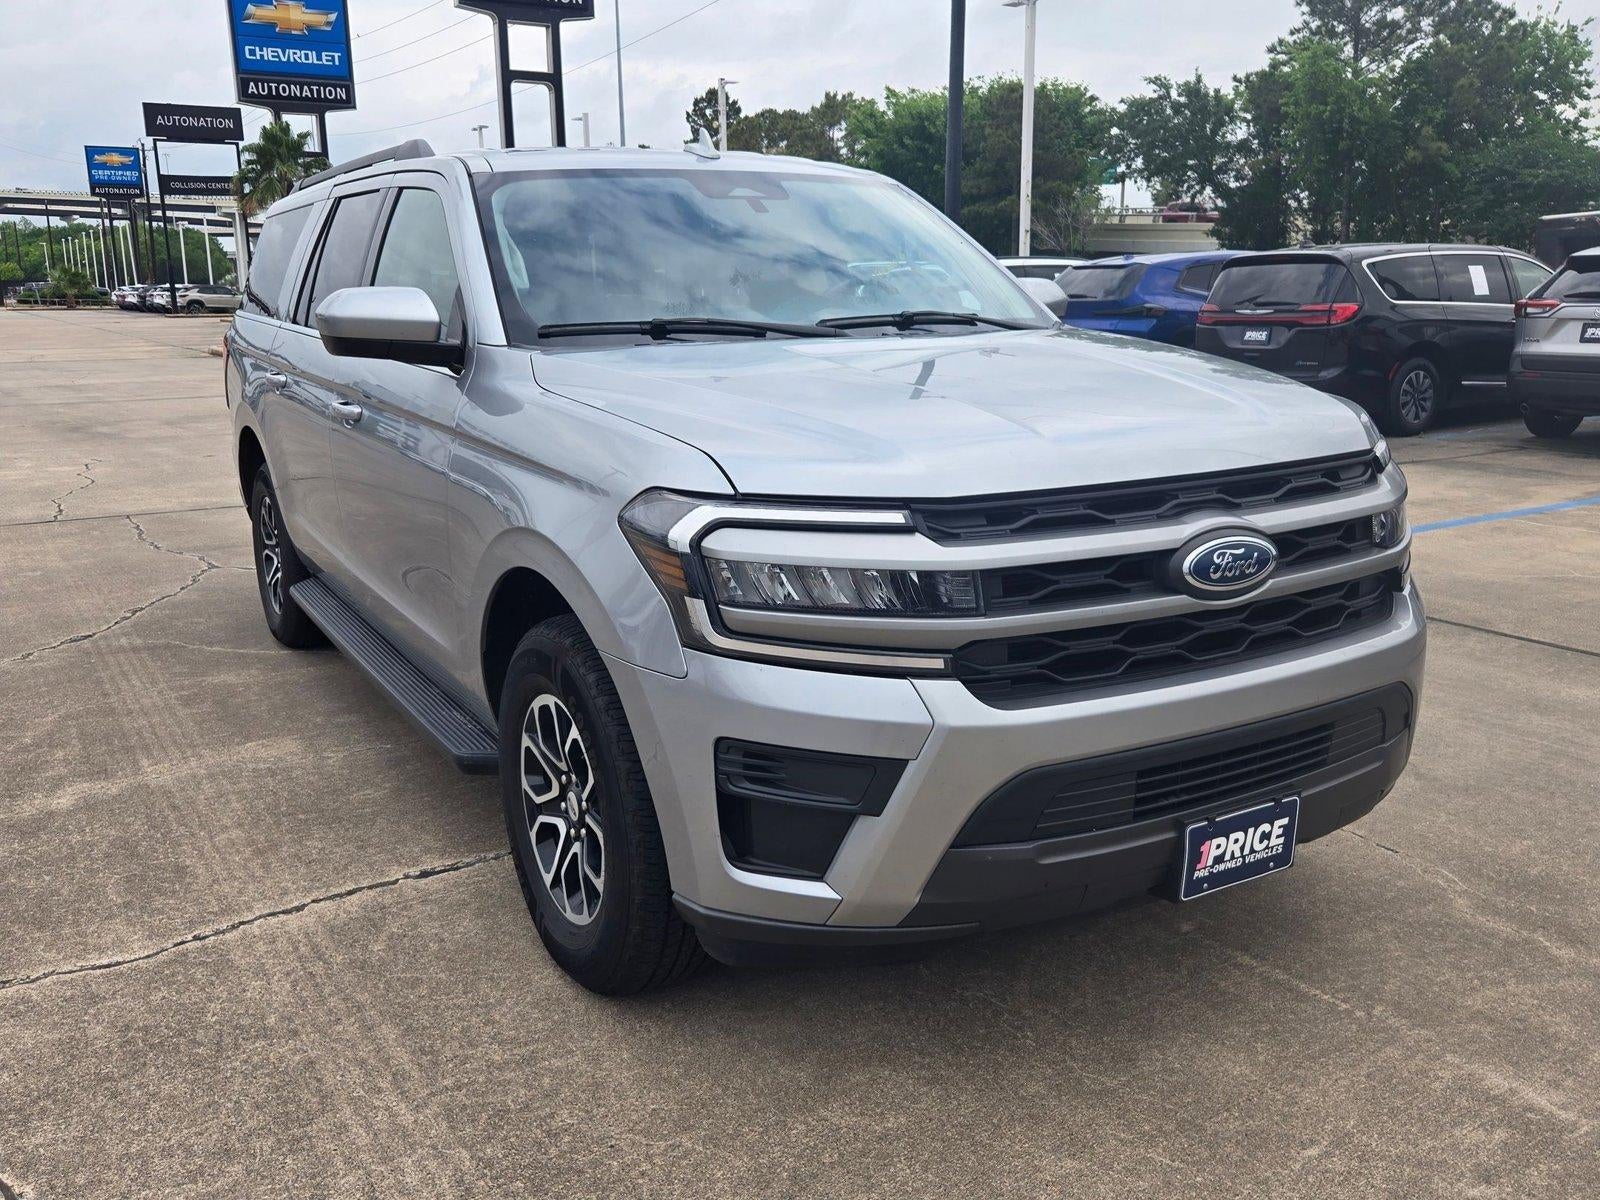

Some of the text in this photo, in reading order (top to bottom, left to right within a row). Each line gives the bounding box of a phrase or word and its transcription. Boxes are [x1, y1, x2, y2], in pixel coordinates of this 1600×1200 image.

[244, 45, 341, 66] CHEVROLET
[248, 81, 347, 100] AUTONATION
[156, 115, 234, 129] AUTONATION
[92, 169, 139, 177] CERTIFIED
[95, 187, 140, 195] AUTONATION
[170, 181, 206, 190] COLLISION
[1209, 547, 1258, 580] Ford
[1196, 817, 1289, 870] 1PRICE
[1193, 844, 1283, 880] PRE-OWNED VEHICLES
